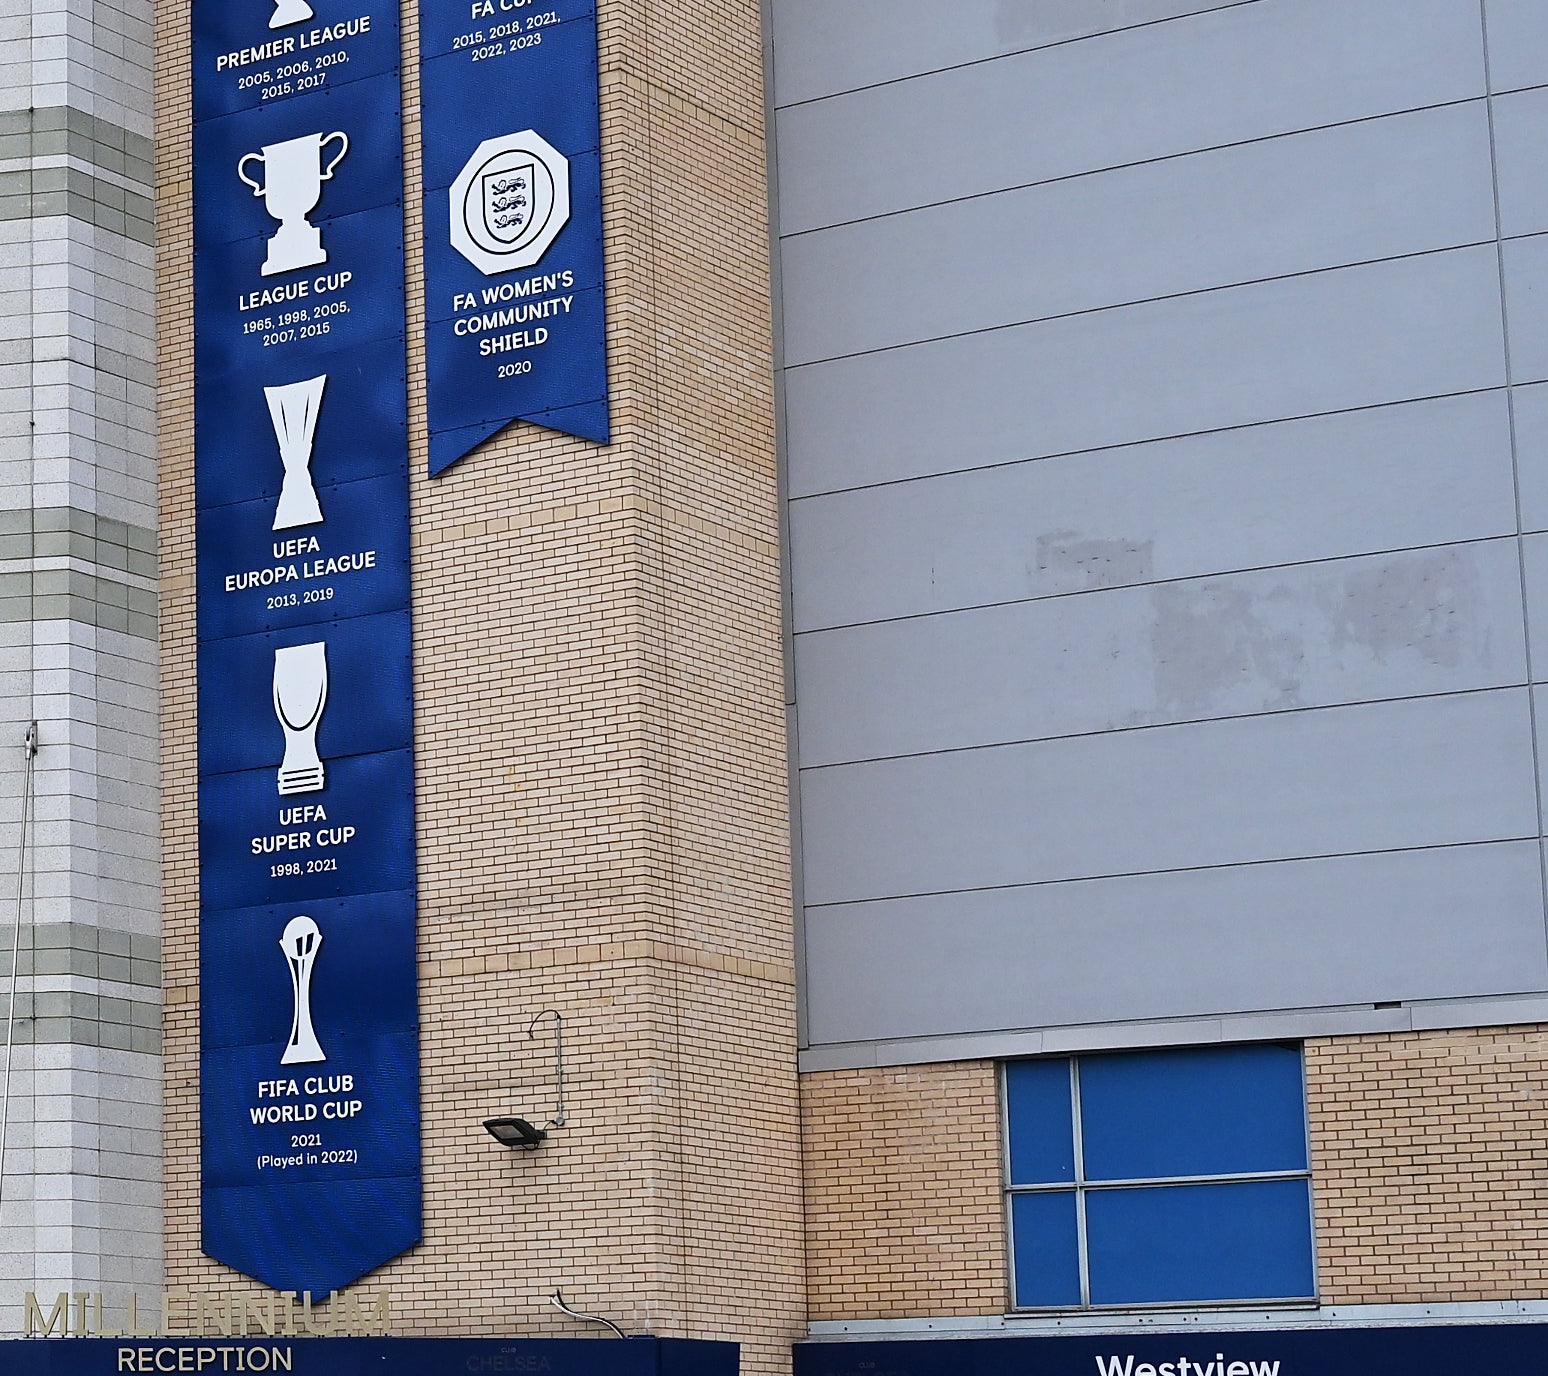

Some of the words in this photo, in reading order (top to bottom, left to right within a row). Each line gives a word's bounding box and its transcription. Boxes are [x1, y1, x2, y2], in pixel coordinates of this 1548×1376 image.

[471, 0, 495, 20] FA
[216, 36, 295, 72] PREMIER
[300, 15, 371, 49] LEAGUE
[452, 33, 486, 50] 2015,
[489, 21, 523, 40] 2018,
[526, 10, 561, 30] 2021,
[471, 43, 506, 62] 2022,
[509, 33, 542, 52] 2023
[238, 71, 273, 90] 2005,
[276, 61, 312, 81] 2006,
[315, 50, 350, 69] 2010,
[261, 82, 294, 100] 2015,
[297, 72, 327, 90] 2017
[239, 280, 309, 312] LEAGUE
[313, 270, 353, 295] CUP
[453, 294, 477, 312] FA
[481, 270, 574, 306] WOMEN'S
[243, 317, 275, 334] 1965,
[278, 309, 311, 327] 1998,
[313, 300, 351, 319] 2005,
[454, 295, 574, 336] COMMUNITY
[263, 328, 297, 347] 2007,
[300, 321, 330, 338] 2015
[479, 327, 549, 356] SHIELD
[497, 360, 532, 378] 2020
[273, 536, 320, 559] UEFA
[225, 566, 299, 592] EUROPA
[303, 550, 376, 579] LEAGUE
[266, 594, 300, 610] 2013,
[303, 587, 334, 603] 2019
[279, 804, 327, 826] UEFA
[251, 831, 312, 855] SUPER
[316, 826, 356, 844] CUP
[270, 862, 304, 878] 1998,
[306, 858, 338, 873] 2021
[258, 1080, 300, 1098] FIFA
[304, 1075, 354, 1095] CLUB
[250, 1103, 318, 1125] WORLD
[322, 1100, 363, 1118] CUP
[291, 1133, 322, 1148] 2021
[257, 1154, 303, 1170] (Played
[306, 1153, 318, 1165] in
[321, 1149, 358, 1164] 2022)
[23, 1290, 391, 1337] MILLENNIUM
[117, 1346, 293, 1372] RECEPTION
